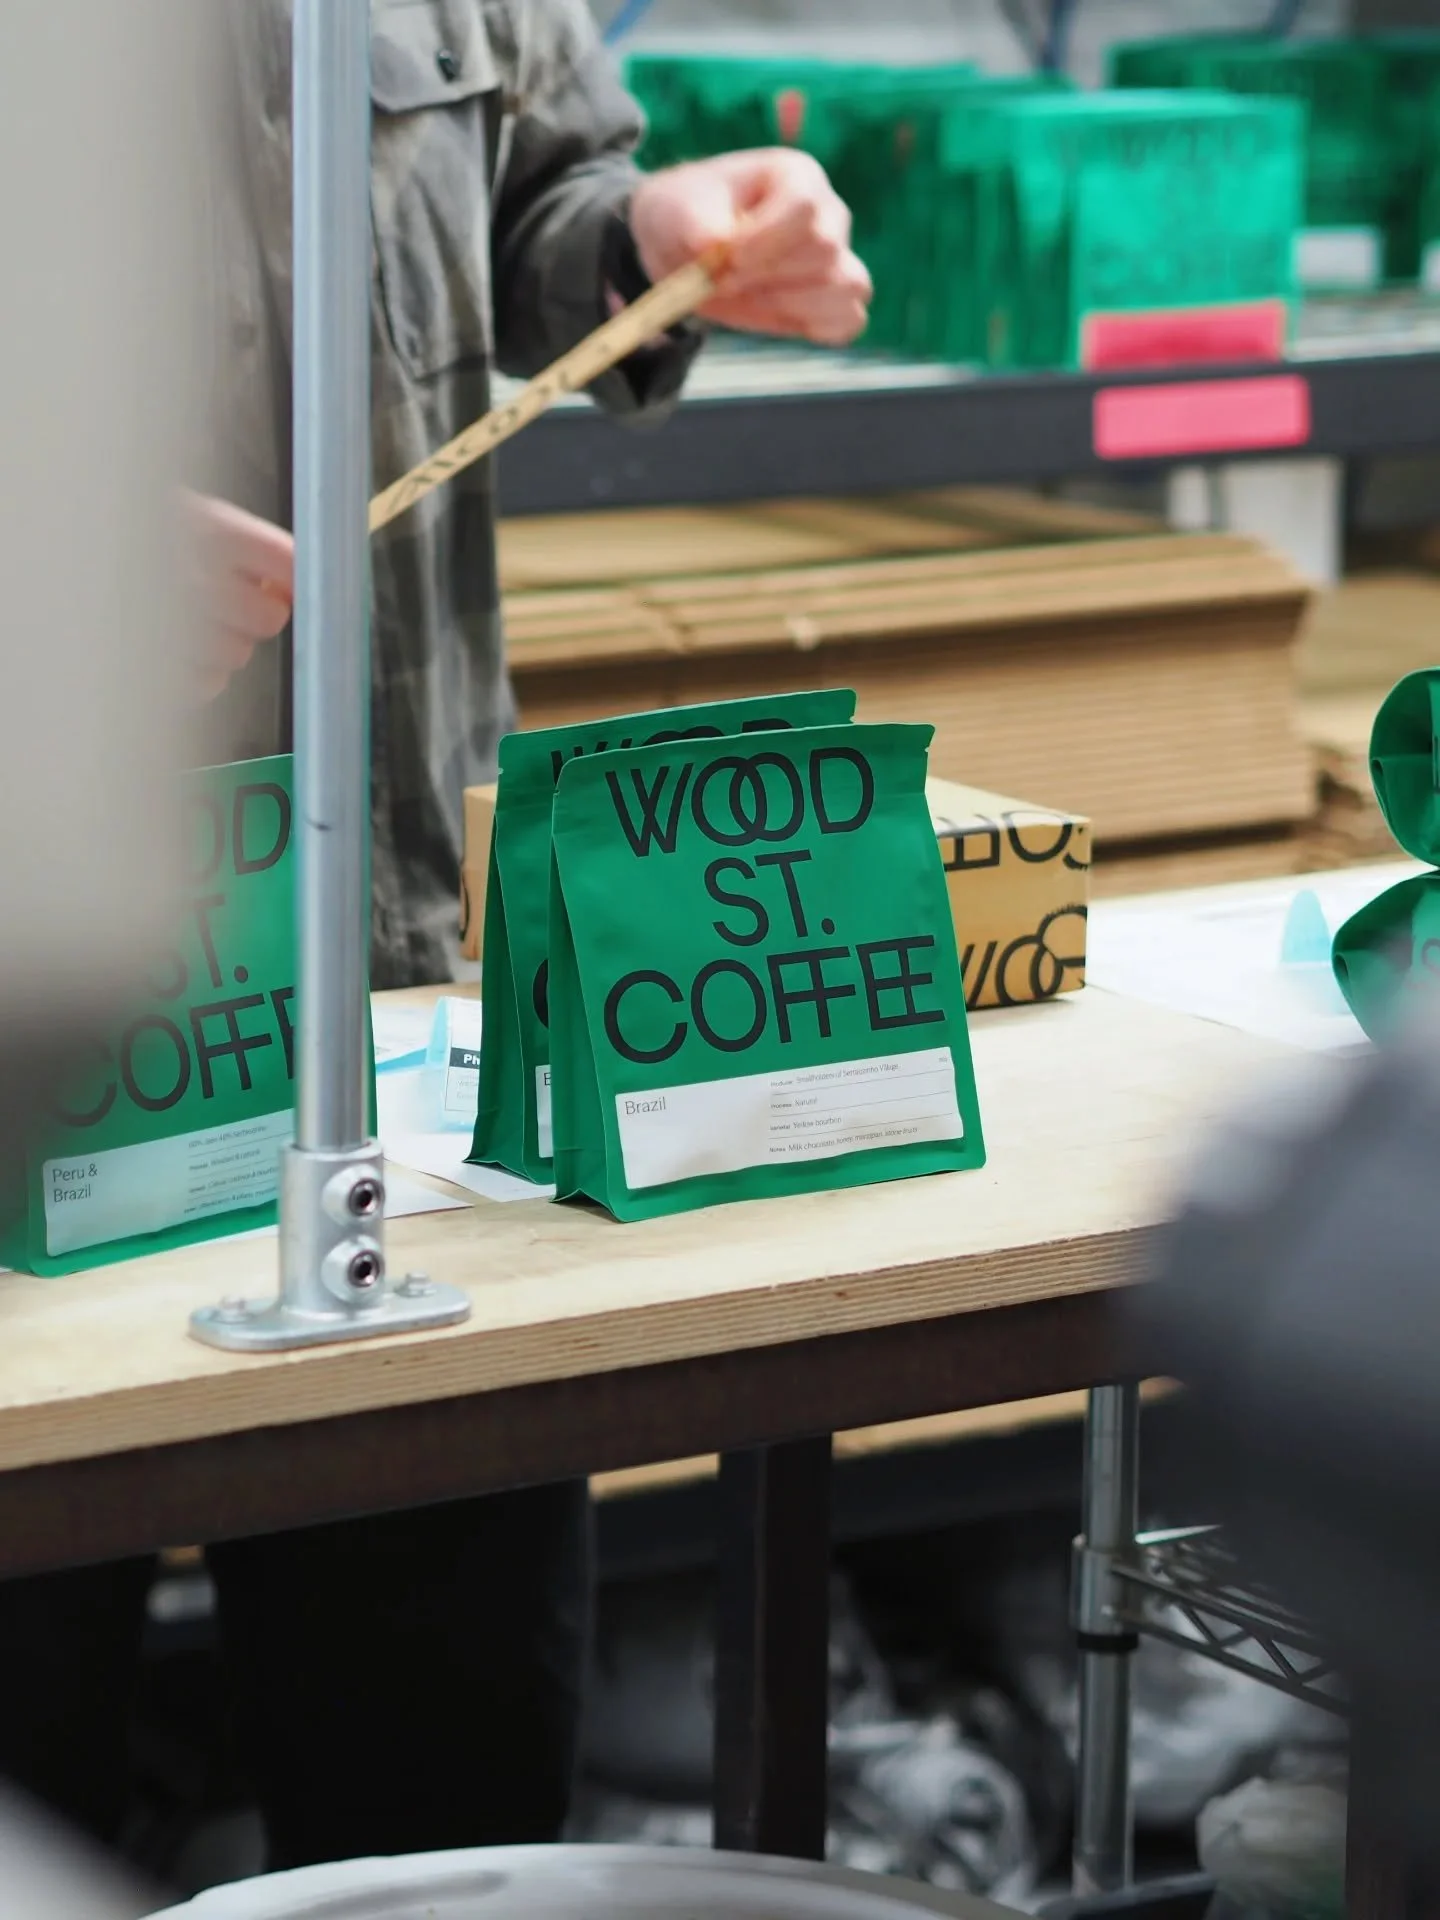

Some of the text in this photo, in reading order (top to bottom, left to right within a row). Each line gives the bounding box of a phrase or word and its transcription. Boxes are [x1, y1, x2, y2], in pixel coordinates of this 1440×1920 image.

[605, 747, 875, 858] WOOD
[704, 850, 836, 947] ST.
[603, 935, 946, 1064] COFFEE
[625, 1096, 667, 1115] Brazil
[52, 1163, 98, 1183] Peru &
[53, 1183, 91, 1203] Brazil
